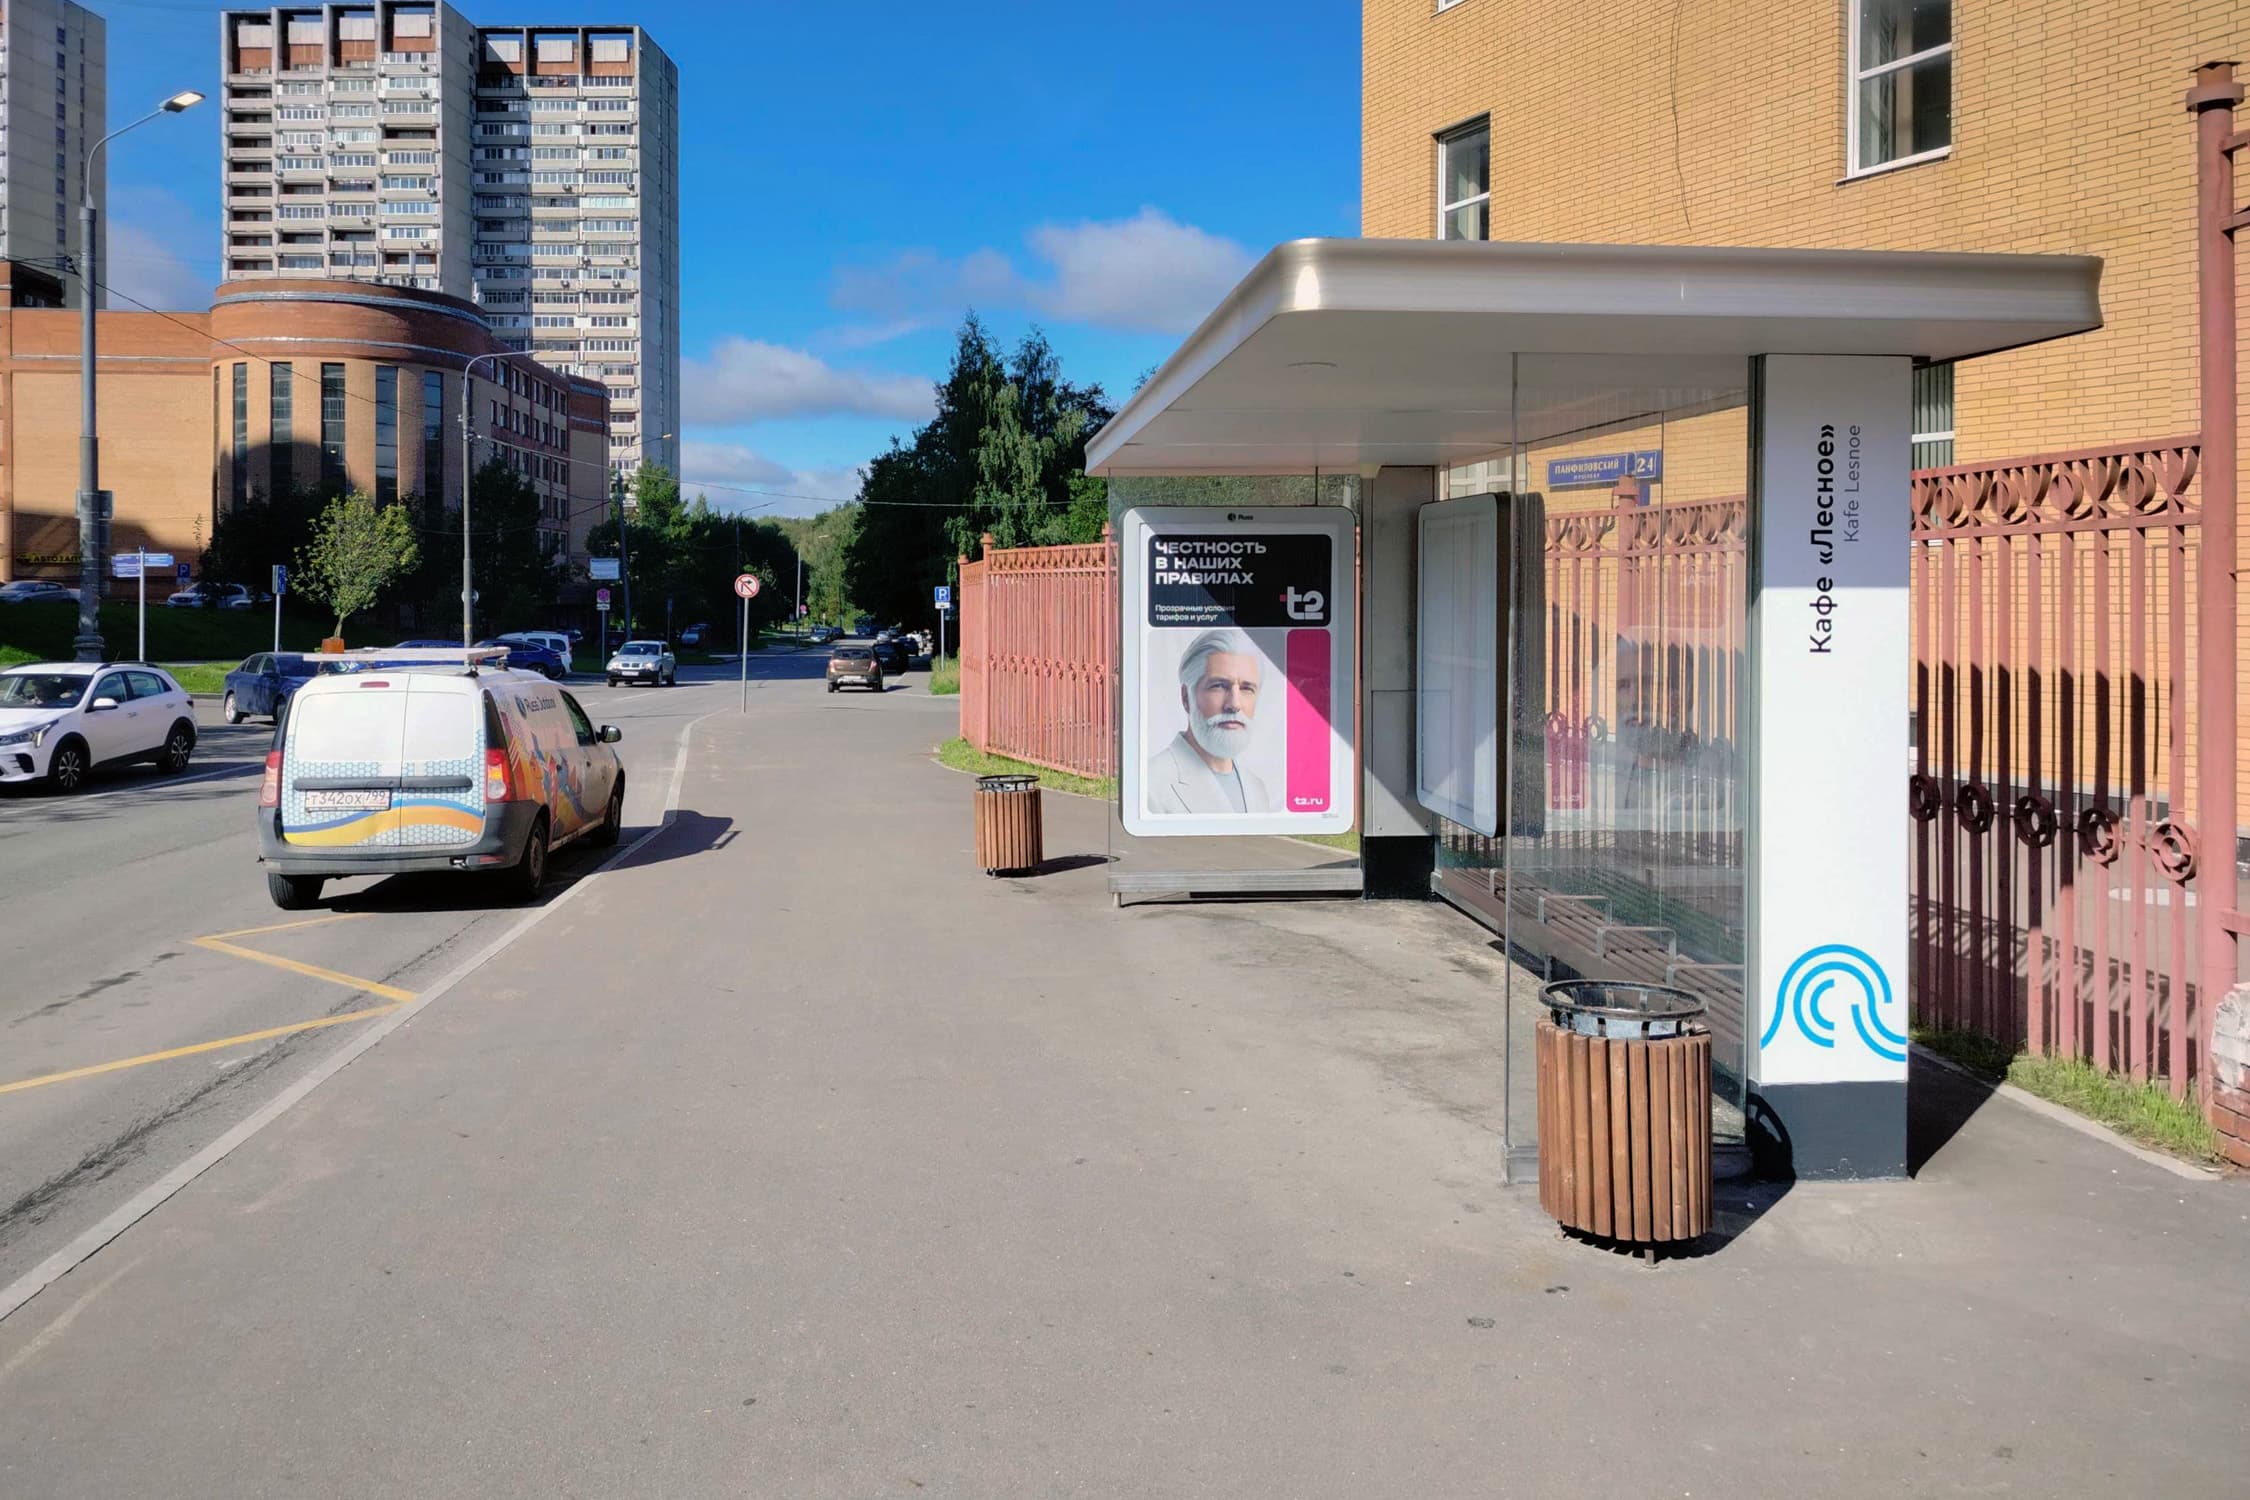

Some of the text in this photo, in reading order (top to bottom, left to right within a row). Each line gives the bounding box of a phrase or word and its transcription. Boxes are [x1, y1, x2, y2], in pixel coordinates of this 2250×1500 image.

[1555, 459, 1619, 474] ПАНФИЛОВСКИЙ
[1637, 457, 1653, 472] 24
[1843, 425, 1861, 542] Kafe Lesnoe
[1809, 424, 1838, 653] Кафе «Лесное»
[1155, 542, 1267, 554] ЧЕСТНОСТЬ
[1155, 557, 1242, 569] В НАШИХ
[1155, 572, 1254, 584] ПРАВИЛАХ
[1286, 586, 1324, 620] t2
[1294, 797, 1324, 805] t2.ru
